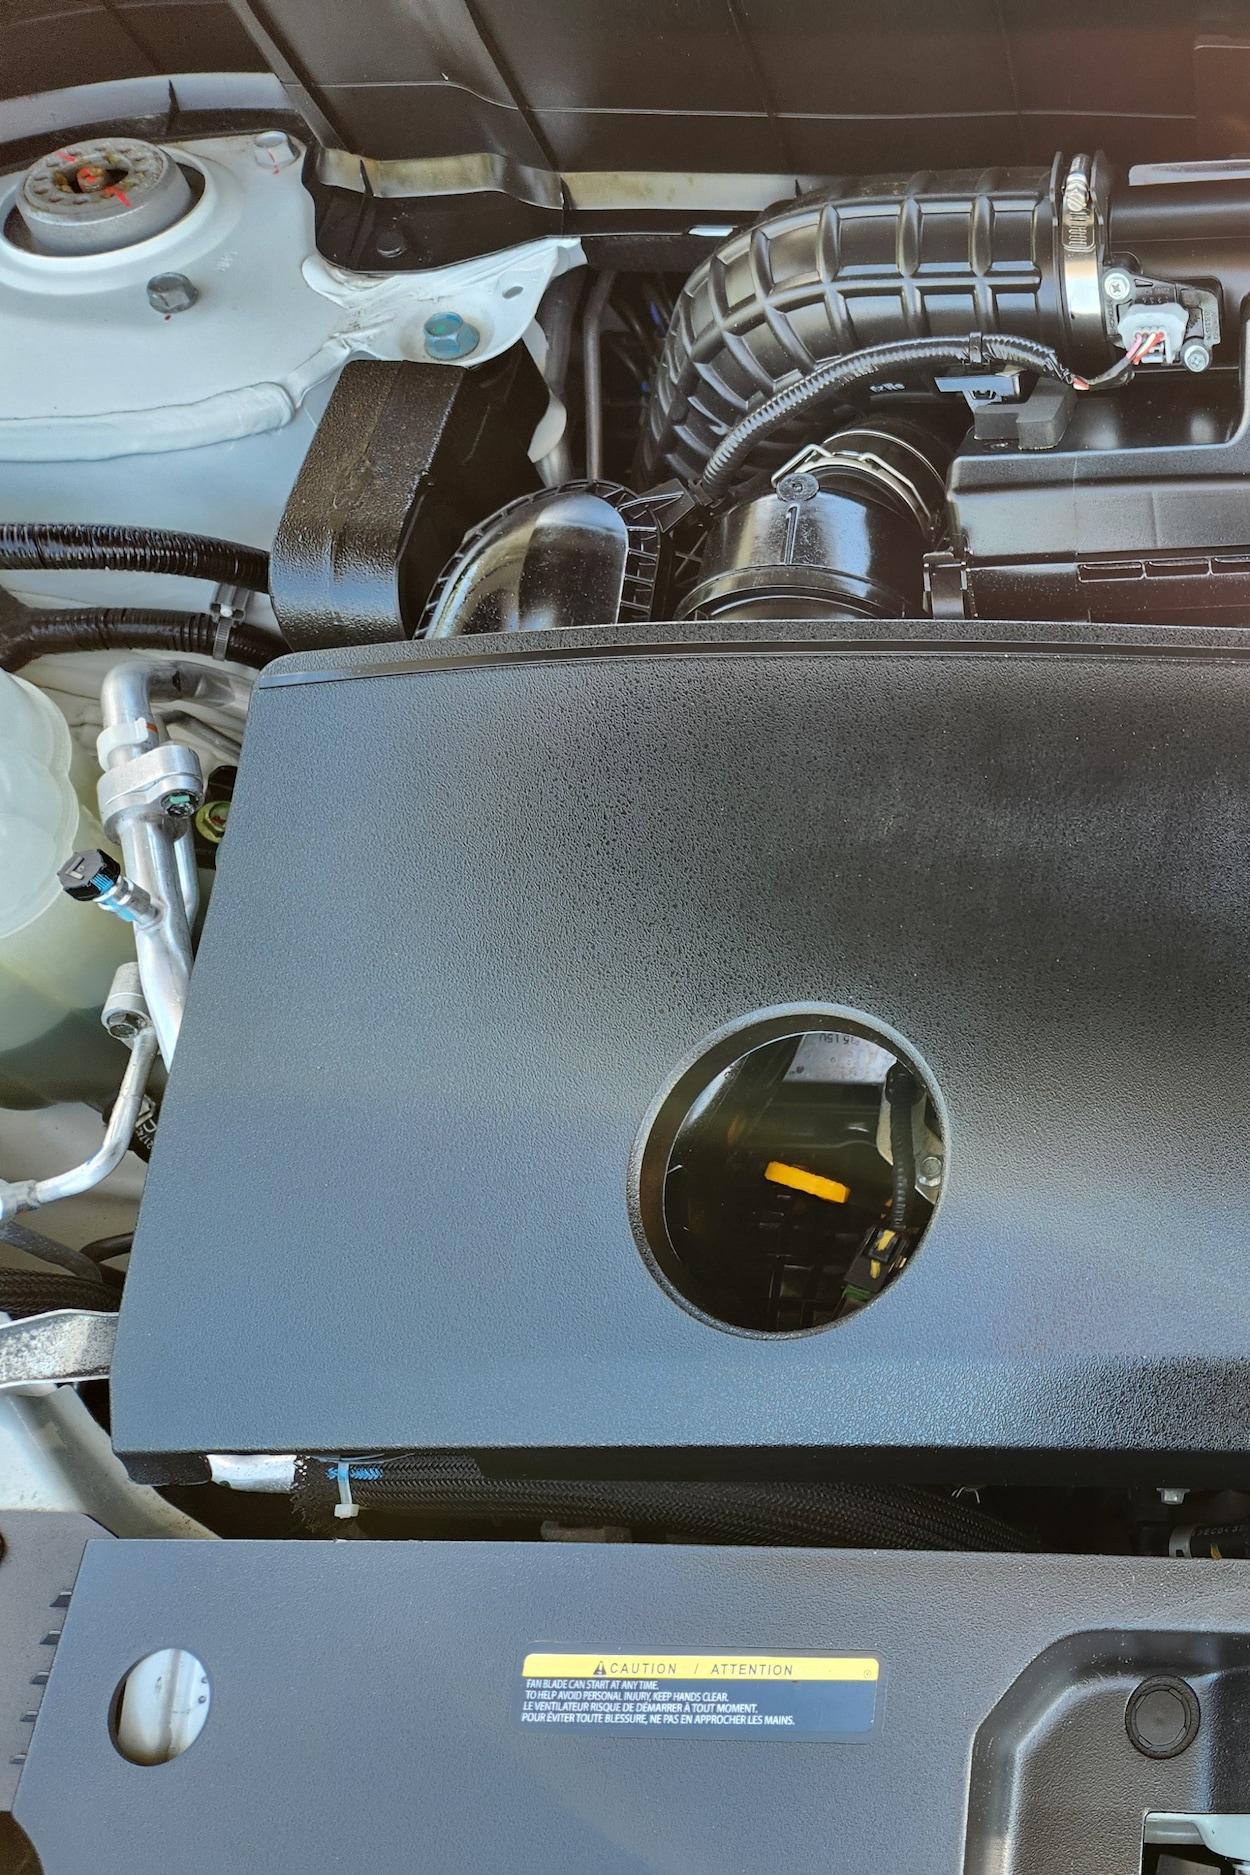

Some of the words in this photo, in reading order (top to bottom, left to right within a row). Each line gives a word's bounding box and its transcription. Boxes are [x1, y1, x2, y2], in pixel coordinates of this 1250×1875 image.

[610, 1663, 677, 1674] CAUTION
[711, 1665, 794, 1676] ATTENTION
[526, 1679, 542, 1688] FAN
[543, 1680, 568, 1689] BLADE
[569, 1680, 585, 1689] CAN
[586, 1680, 609, 1689] START
[611, 1681, 620, 1689] AT
[526, 1690, 536, 1699] TO
[537, 1691, 557, 1700] HELP
[558, 1691, 582, 1700] AVOID
[583, 1691, 622, 1701] PERSONAL
[624, 1692, 652, 1702] INJURY,
[653, 1692, 672, 1701] KEEP
[673, 1692, 701, 1702] HANDS
[702, 1692, 729, 1702] CLEAR.
[523, 1702, 534, 1710] LE
[535, 1702, 589, 1711] VENTILATEUR
[590, 1702, 621, 1713] RISQUE
[622, 1703, 635, 1712] DE
[636, 1702, 683, 1712] DÉMARRER
[684, 1702, 691, 1713] À
[692, 1703, 716, 1713] TOUT
[716, 1704, 758, 1713] MOMENT.
[522, 1713, 546, 1722] POUR
[547, 1711, 575, 1722] ÉVITER
[576, 1713, 604, 1723] TOUTE
[604, 1714, 648, 1725] BLESSURE,
[650, 1714, 662, 1724] NE
[663, 1715, 679, 1724] PAS
[680, 1715, 693, 1724] EN
[694, 1715, 746, 1724] APPROCHER
[747, 1716, 763, 1724] LES
[764, 1716, 795, 1725] MAINS.
